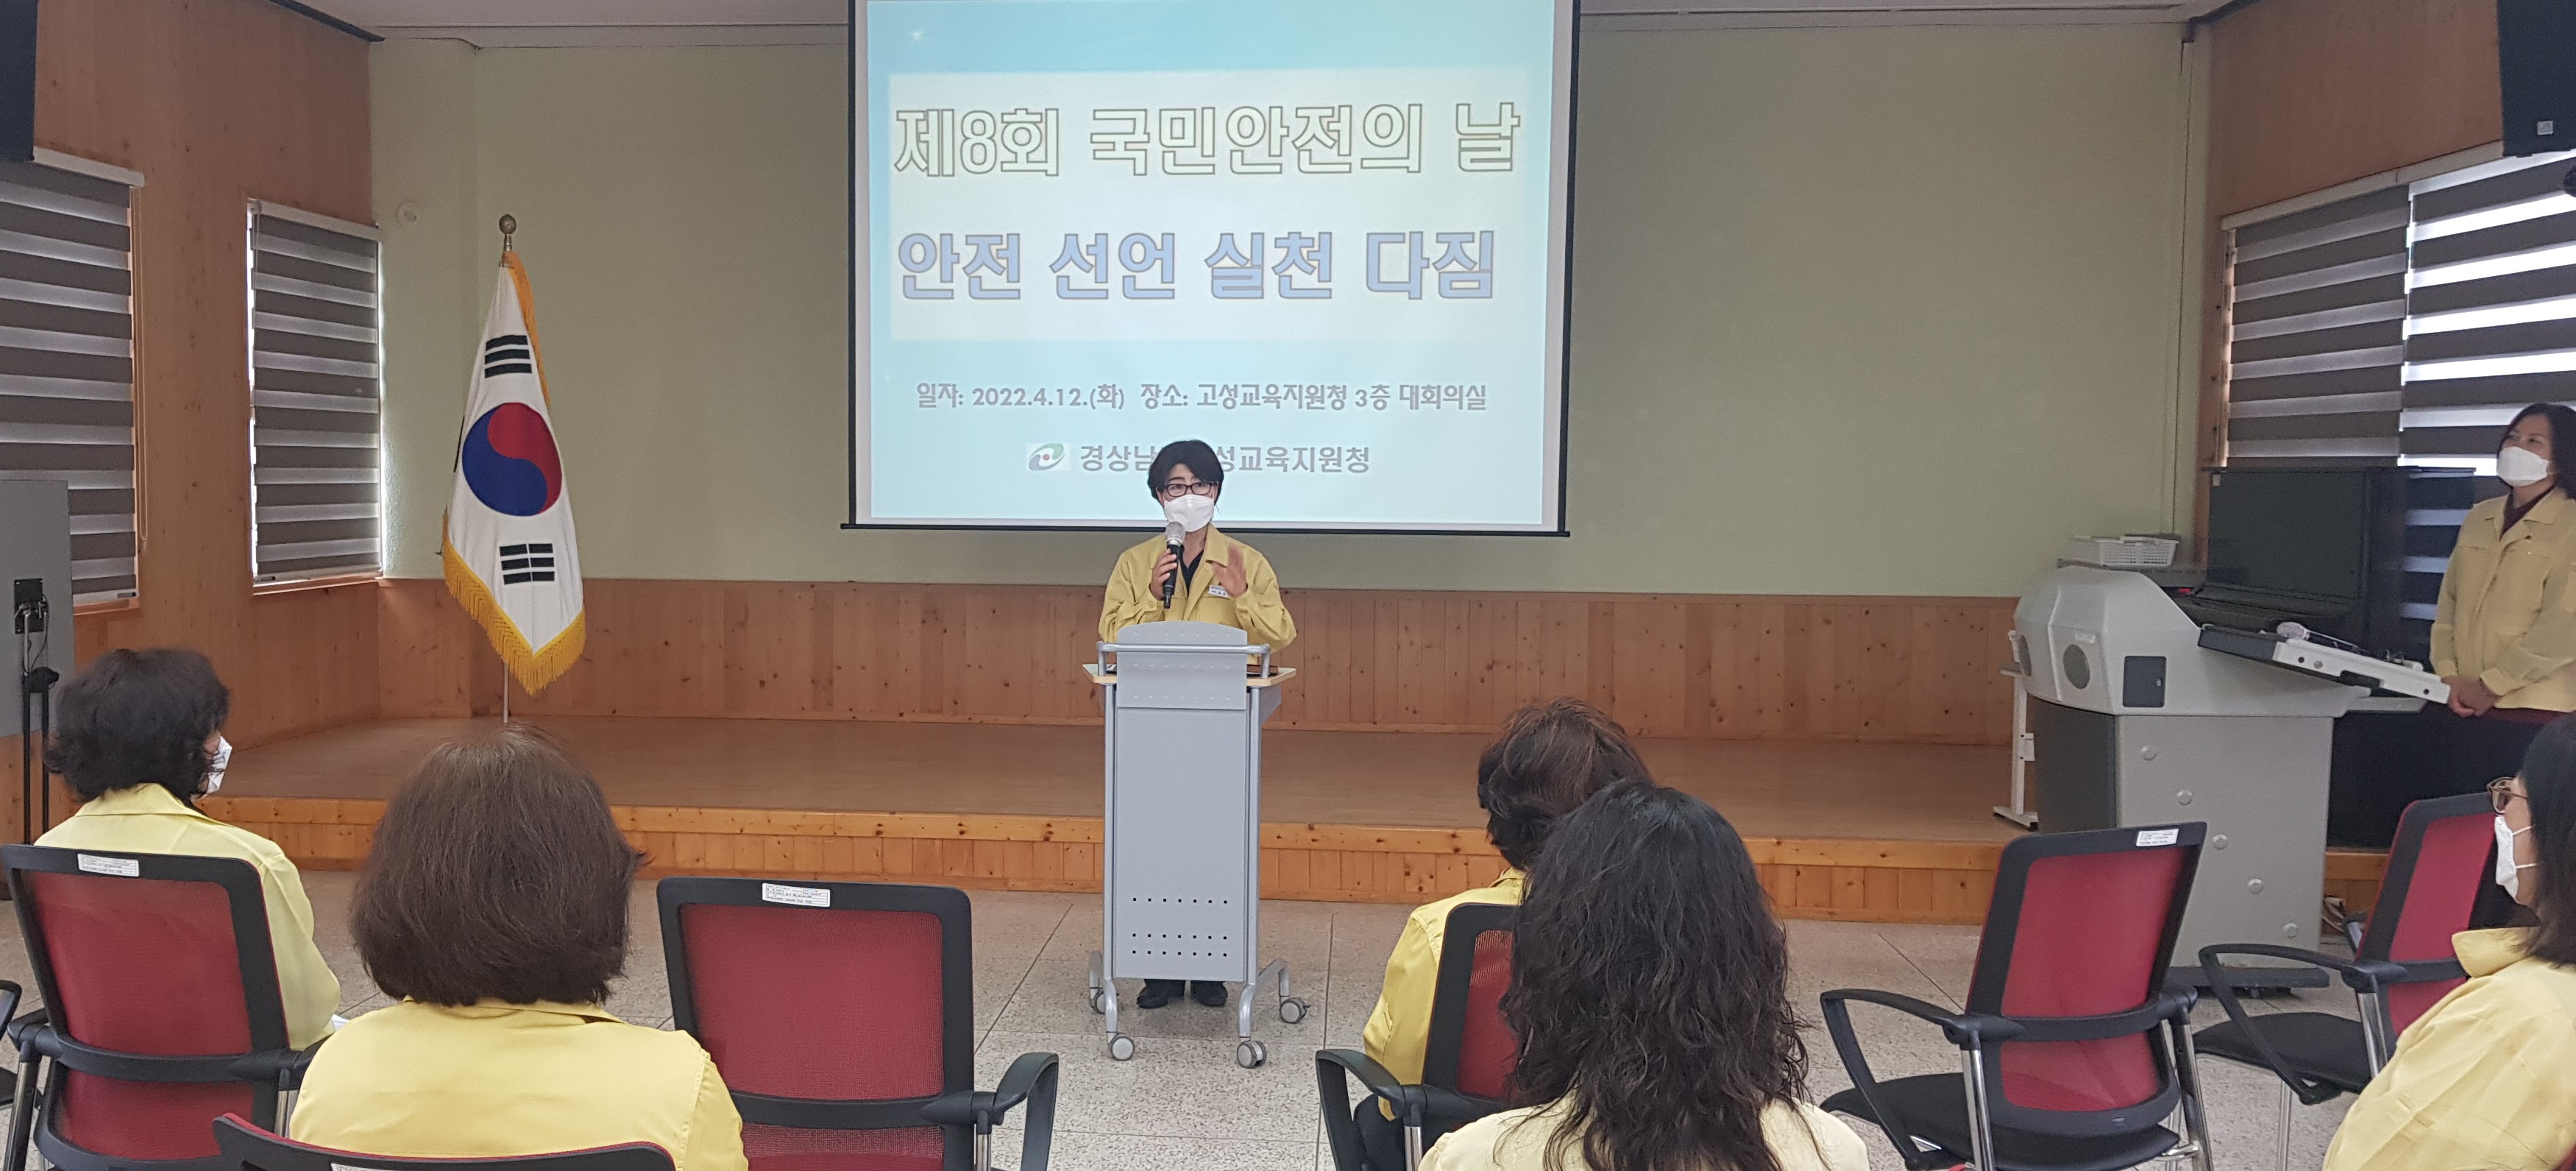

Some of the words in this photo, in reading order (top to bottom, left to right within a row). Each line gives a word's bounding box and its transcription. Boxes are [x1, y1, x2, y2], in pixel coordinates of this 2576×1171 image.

[894, 107, 1060, 177] 제8회
[1089, 103, 1423, 176] 국민안전의
[1455, 101, 1522, 172] 날
[898, 233, 1022, 300] 안전
[1050, 233, 1177, 300] 선언
[1204, 231, 1333, 300] 실천
[1366, 230, 1496, 300] 다짐
[916, 382, 964, 408] 일자:
[971, 383, 1125, 410] 2022.4.12.(화)
[1140, 383, 1188, 410] 장소:
[1196, 383, 1347, 411] 고성교육지원청
[1355, 384, 1391, 411] 3층
[1399, 383, 1488, 411] 대회의실
[1080, 444, 1370, 473] 경상남성교육지원청
